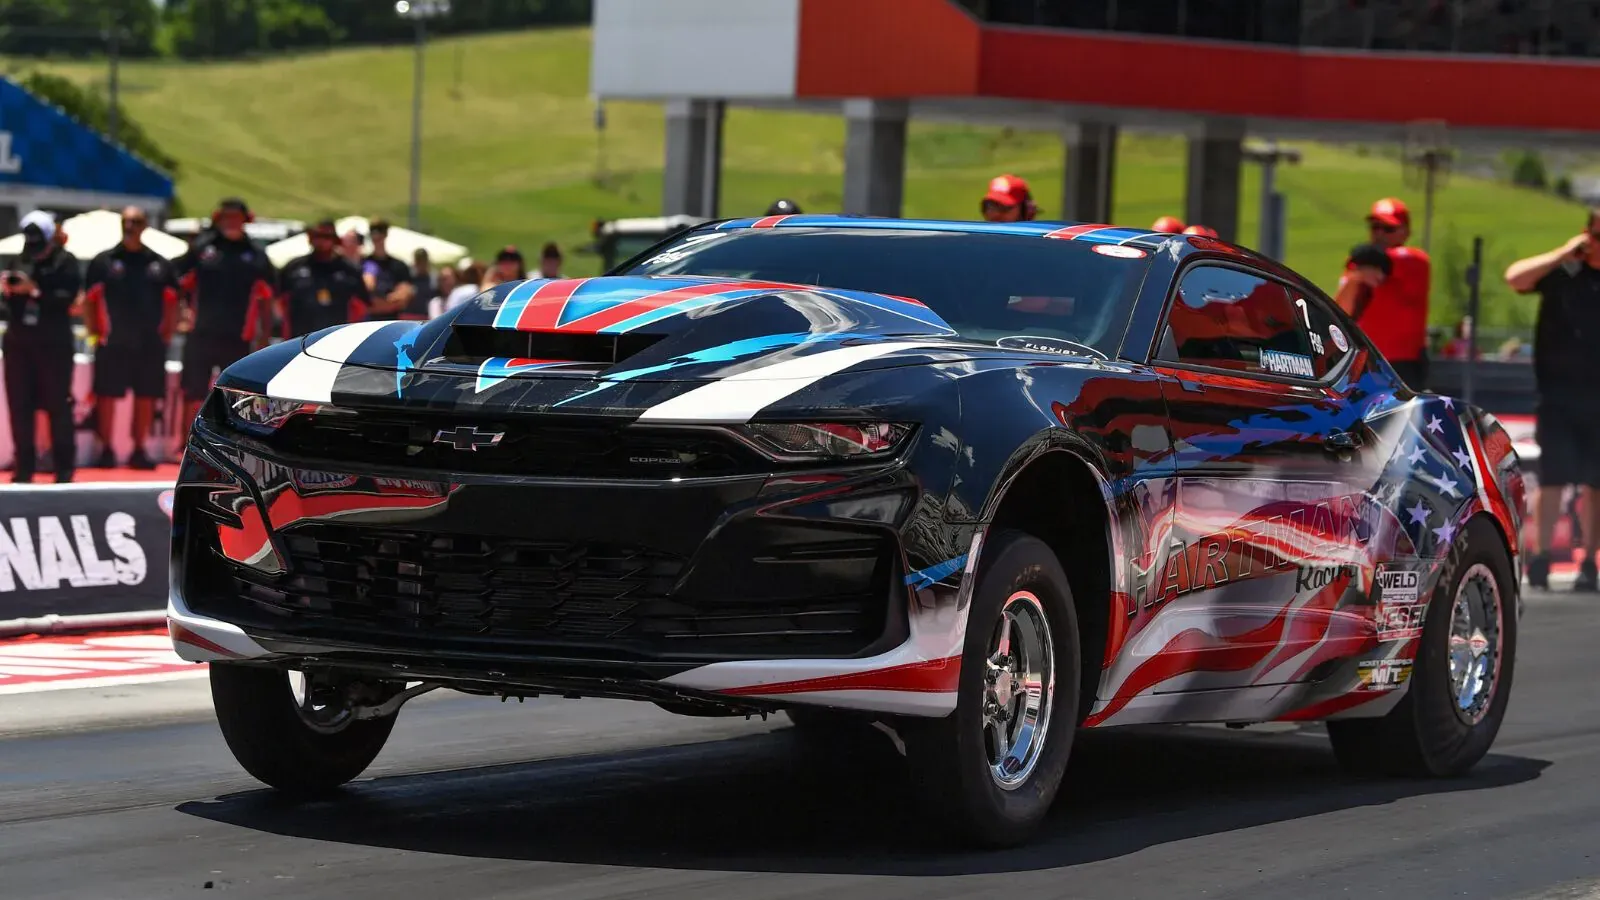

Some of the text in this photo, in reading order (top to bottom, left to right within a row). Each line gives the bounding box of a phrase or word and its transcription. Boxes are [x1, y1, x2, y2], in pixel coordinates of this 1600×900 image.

[1295, 298, 1311, 330] 7
[1268, 352, 1314, 377] HARTMAN
[1127, 495, 1371, 616] HARTMAN
[1383, 572, 1418, 589] WELD
[1371, 666, 1402, 684] M/T
